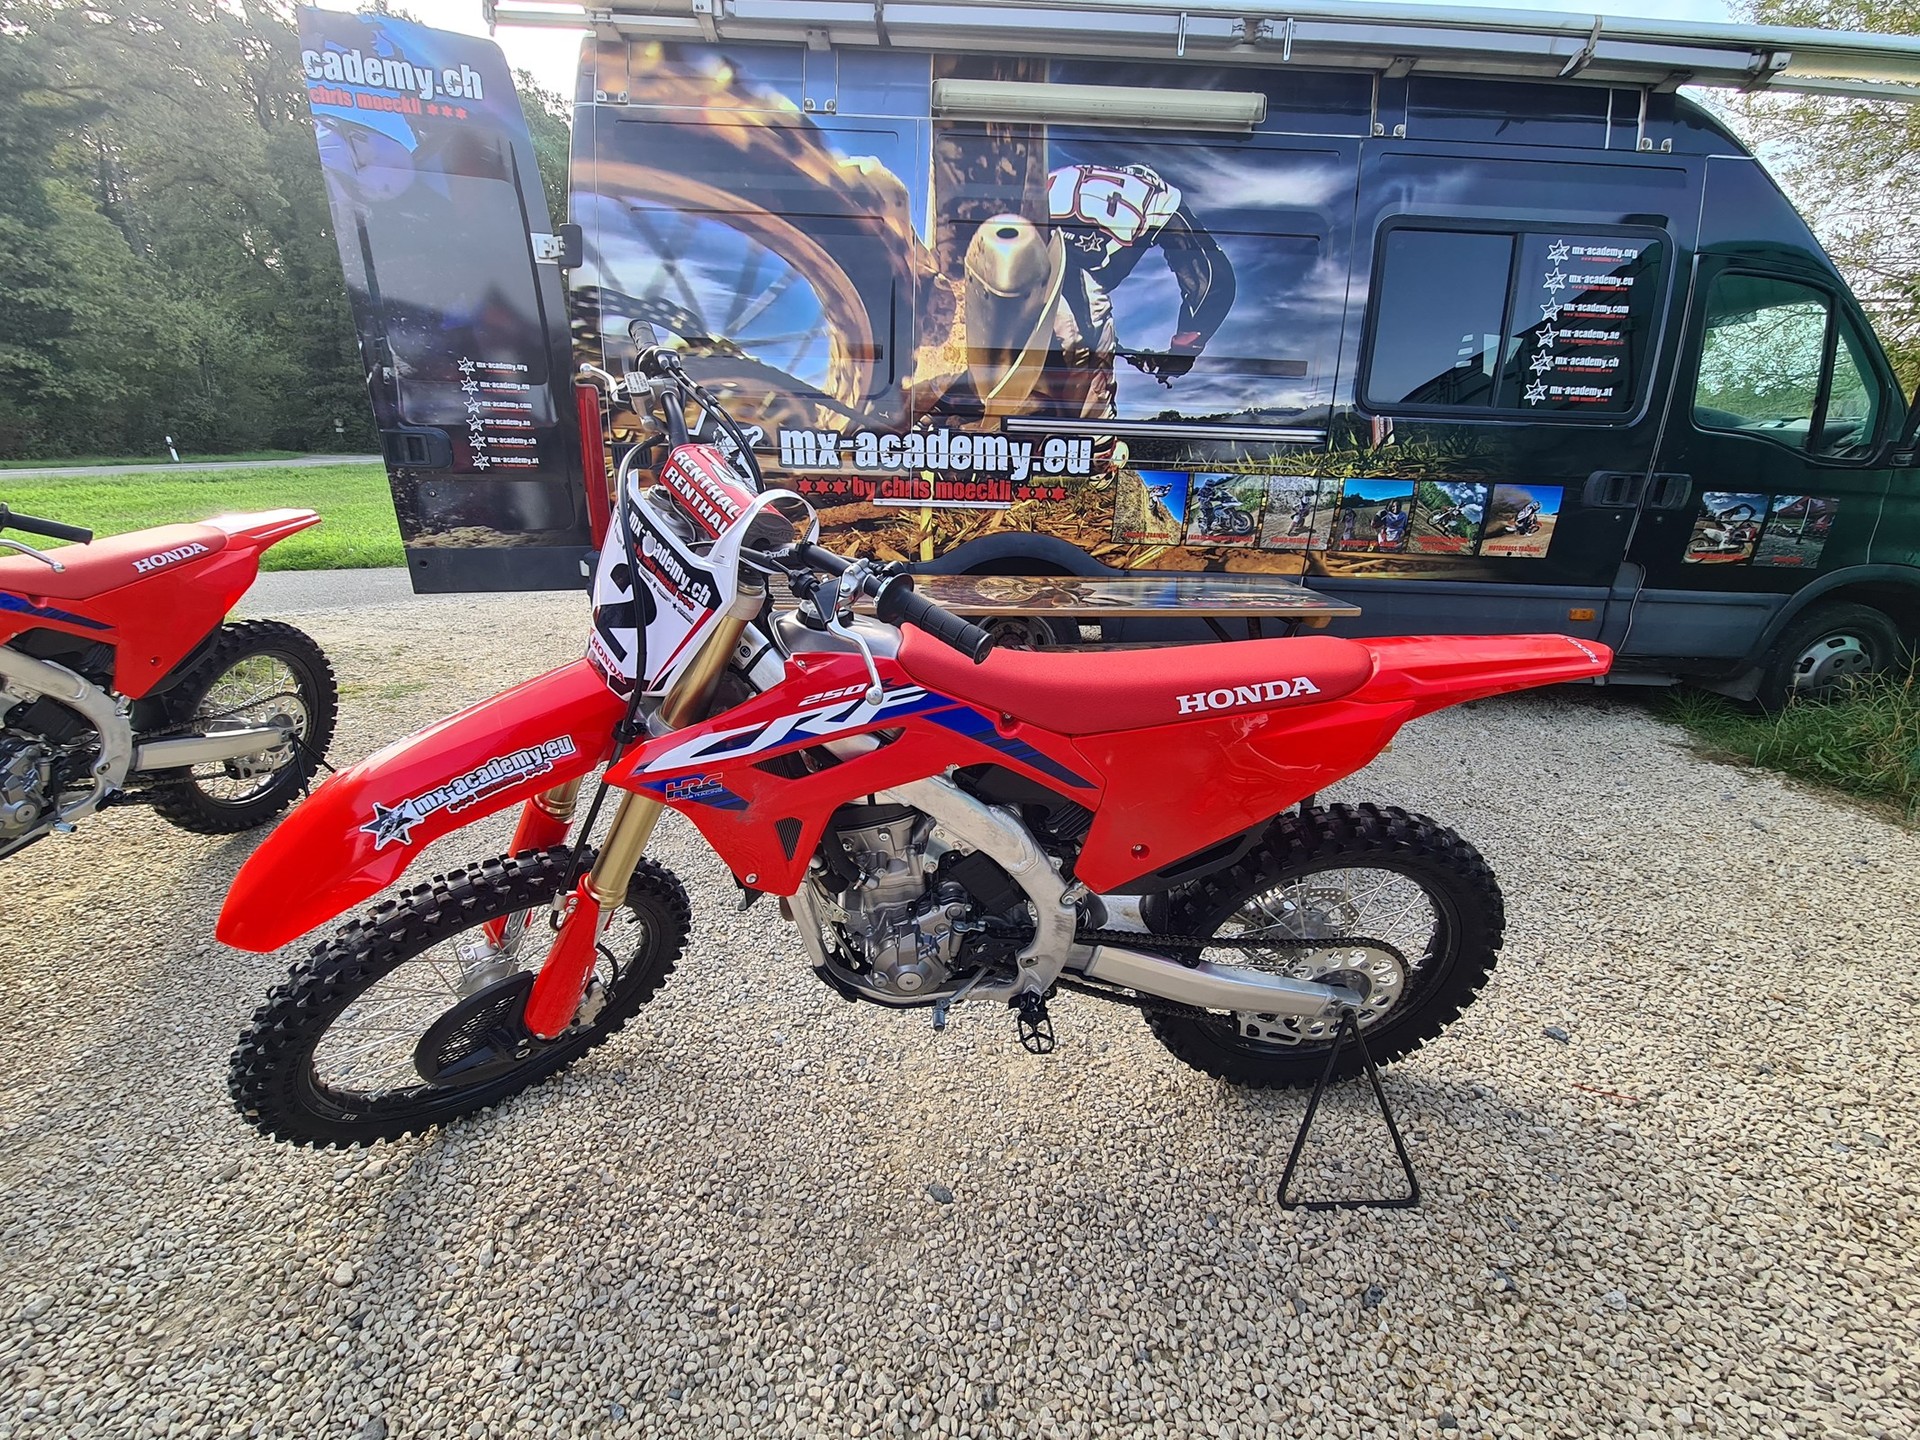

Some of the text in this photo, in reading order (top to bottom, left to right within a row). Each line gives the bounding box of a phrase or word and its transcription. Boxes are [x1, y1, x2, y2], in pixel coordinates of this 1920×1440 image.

[301, 49, 483, 101] cademy.ch
[308, 85, 422, 116] chris moeckli
[1571, 245, 1638, 260] mx-academy.org
[1568, 274, 1634, 287] mx-academy.eu
[1563, 303, 1630, 315] mx-academy.com
[1559, 328, 1620, 341] mx-academy.ae
[1554, 356, 1620, 369] mx-academy.ch
[1549, 385, 1614, 398] mx-academy.at
[779, 427, 1093, 481] mx-academy.eu
[664, 465, 731, 536] RENTHAL
[672, 450, 741, 520] RENTHAL
[851, 475, 1012, 502] by chris moeckli
[132, 542, 209, 574] HONDA
[595, 562, 658, 663] 2
[591, 636, 628, 686] HONDA
[1175, 676, 1321, 715] HONDA
[643, 685, 929, 772] CRF
[413, 736, 576, 816] mx-academy.eu
[666, 772, 724, 800] HRC
